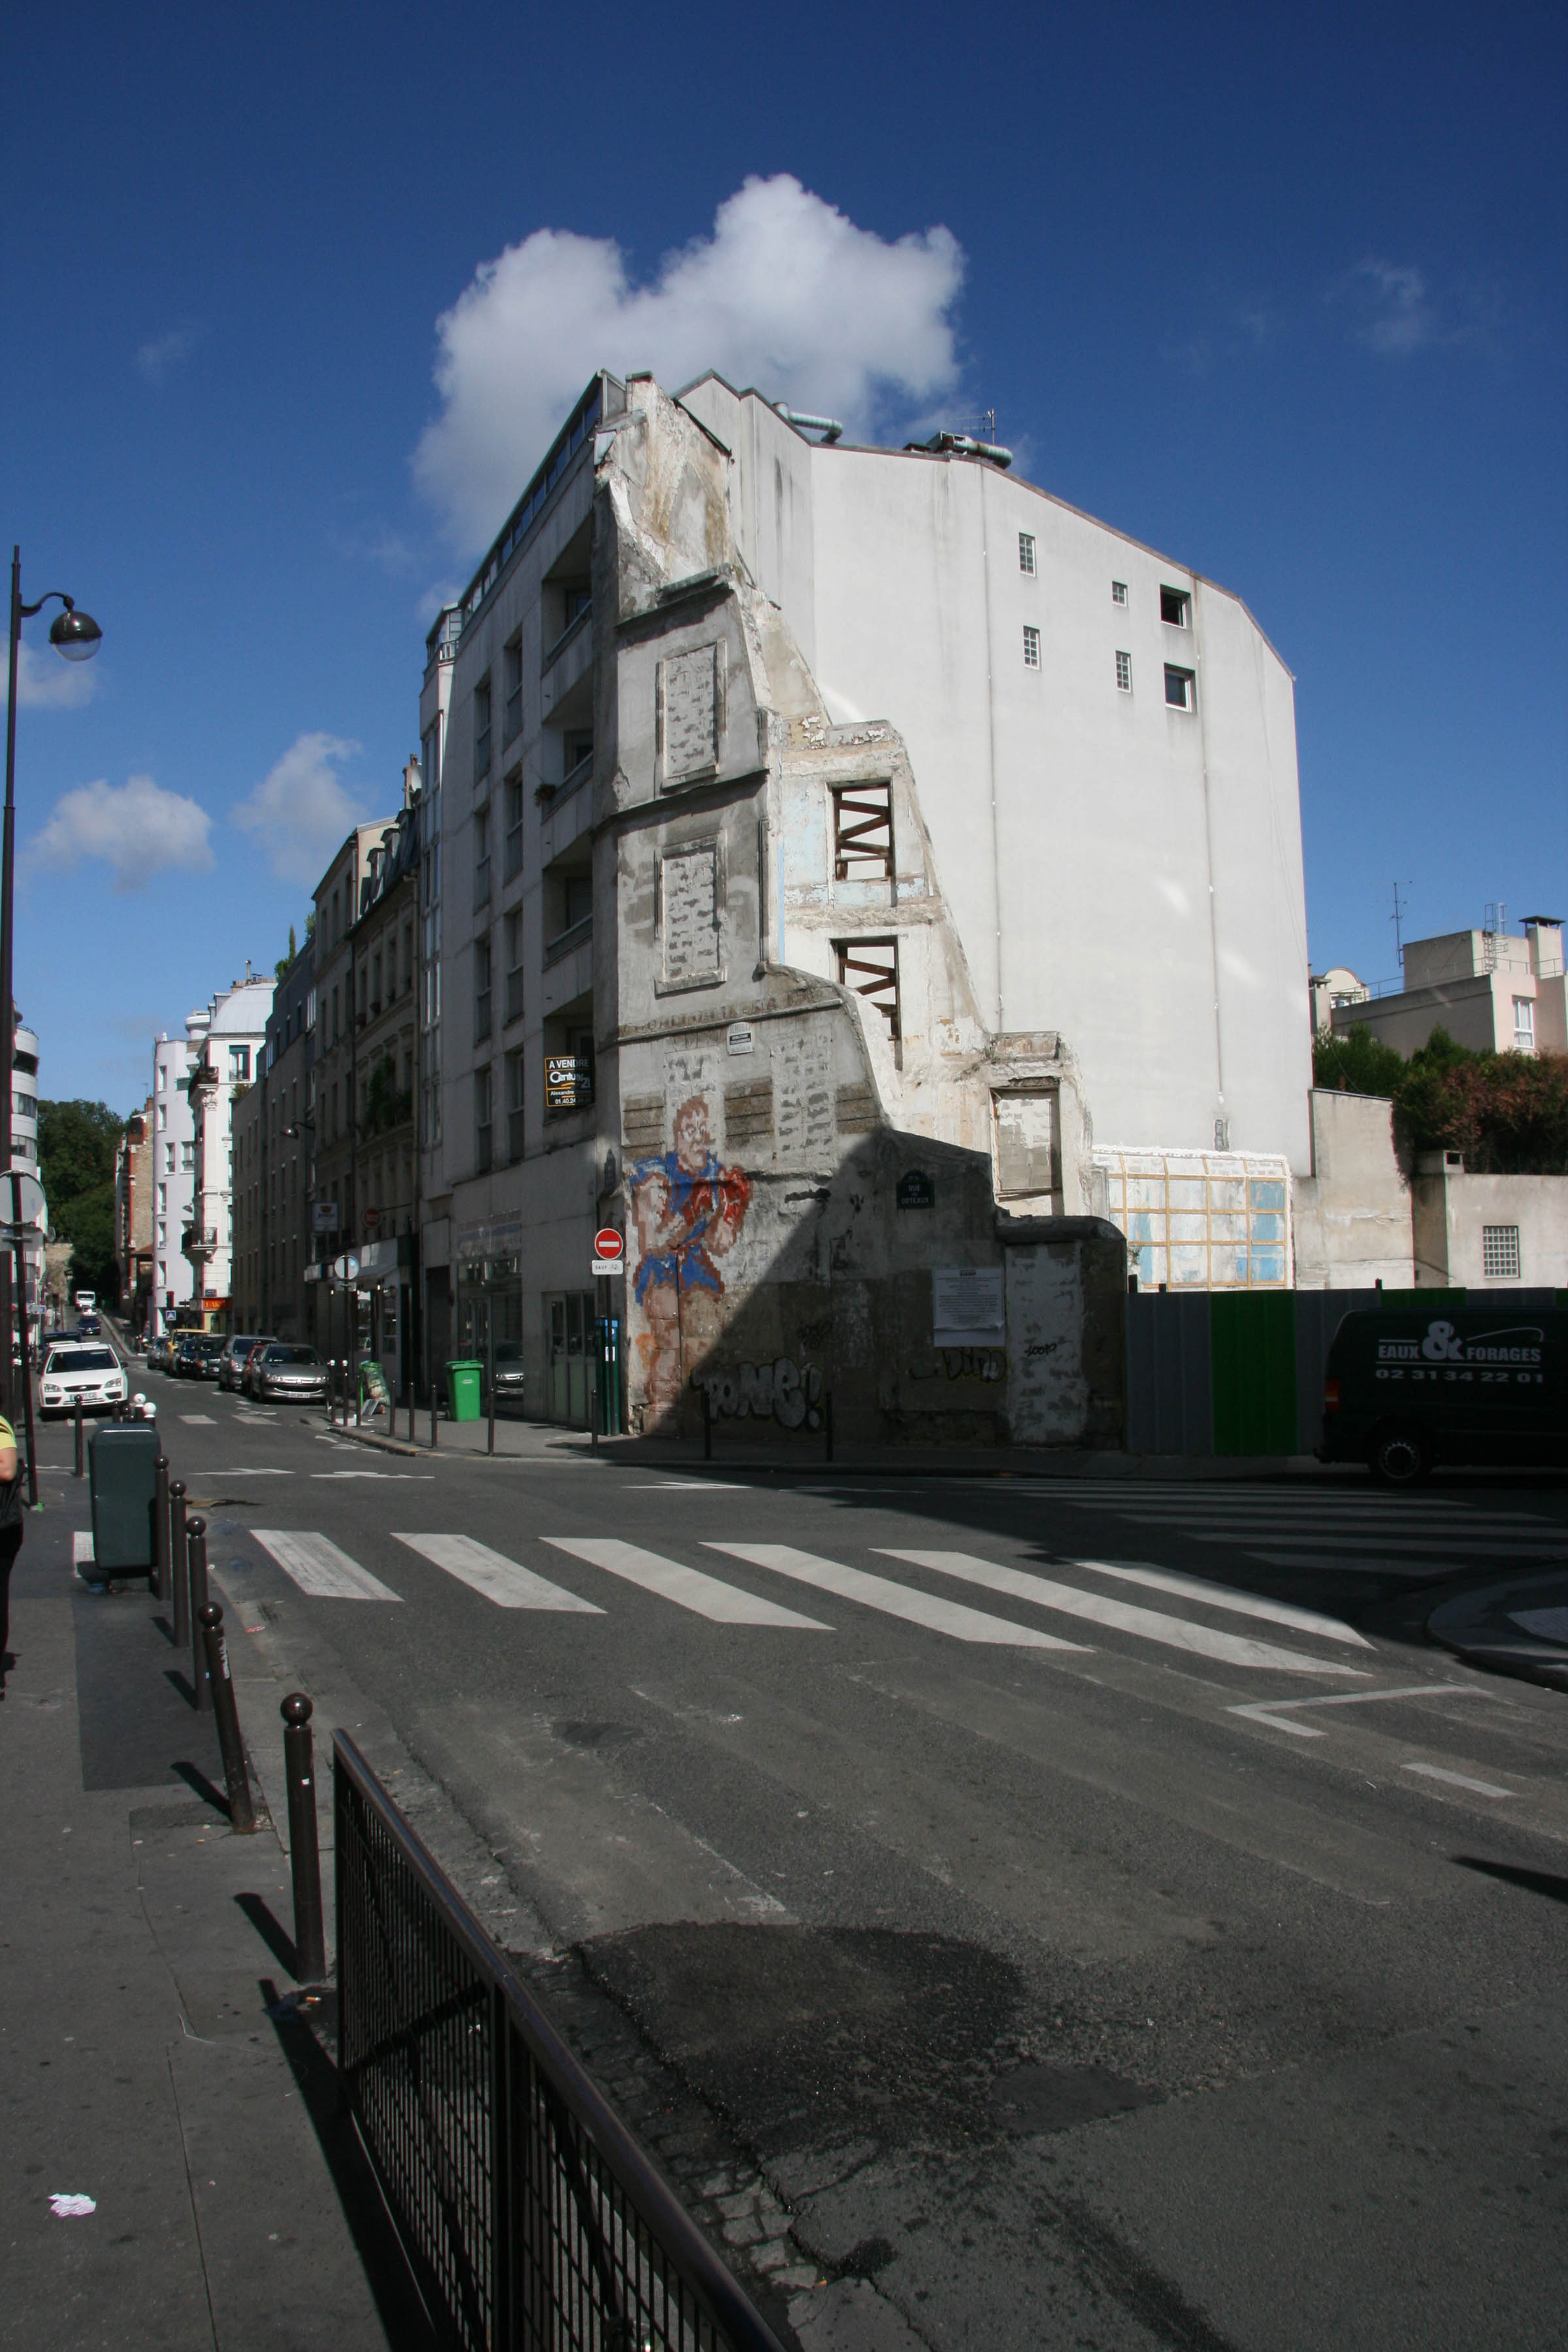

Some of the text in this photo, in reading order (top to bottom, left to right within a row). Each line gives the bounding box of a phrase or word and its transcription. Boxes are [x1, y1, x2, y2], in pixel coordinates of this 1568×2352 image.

[549, 1058, 590, 1069] A VENDRE
[1378, 1320, 1542, 1362] EAUX & FORAGES
[1375, 1369, 1543, 1384] 02 31 34 22 01
